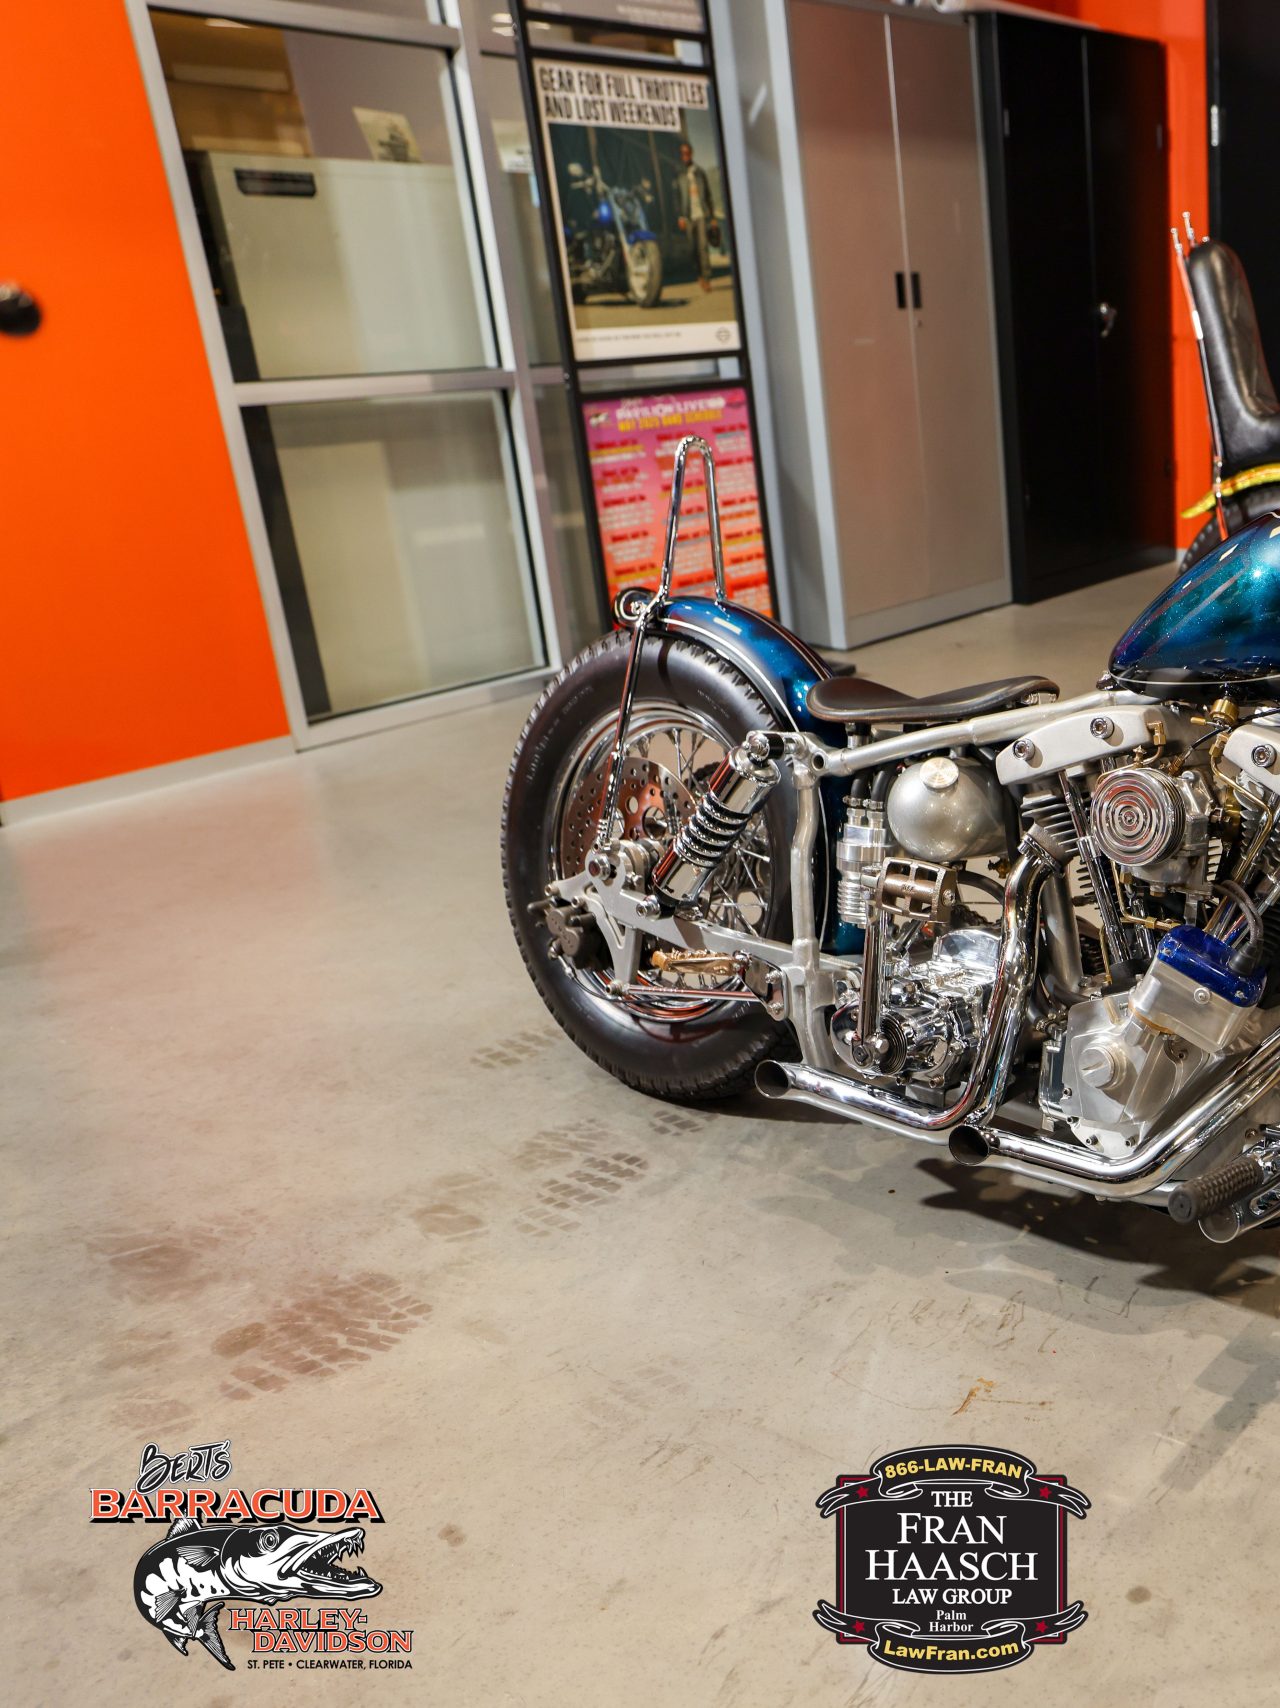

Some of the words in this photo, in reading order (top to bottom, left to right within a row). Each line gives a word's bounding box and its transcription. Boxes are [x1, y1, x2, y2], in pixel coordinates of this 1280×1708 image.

[540, 66, 576, 93] GEAR
[578, 70, 603, 96] FOR
[606, 74, 635, 99] FULL
[638, 77, 705, 105] THROTTLES
[545, 96, 573, 119] AND
[576, 98, 607, 121] LOST
[610, 101, 677, 127] WEEKENDS
